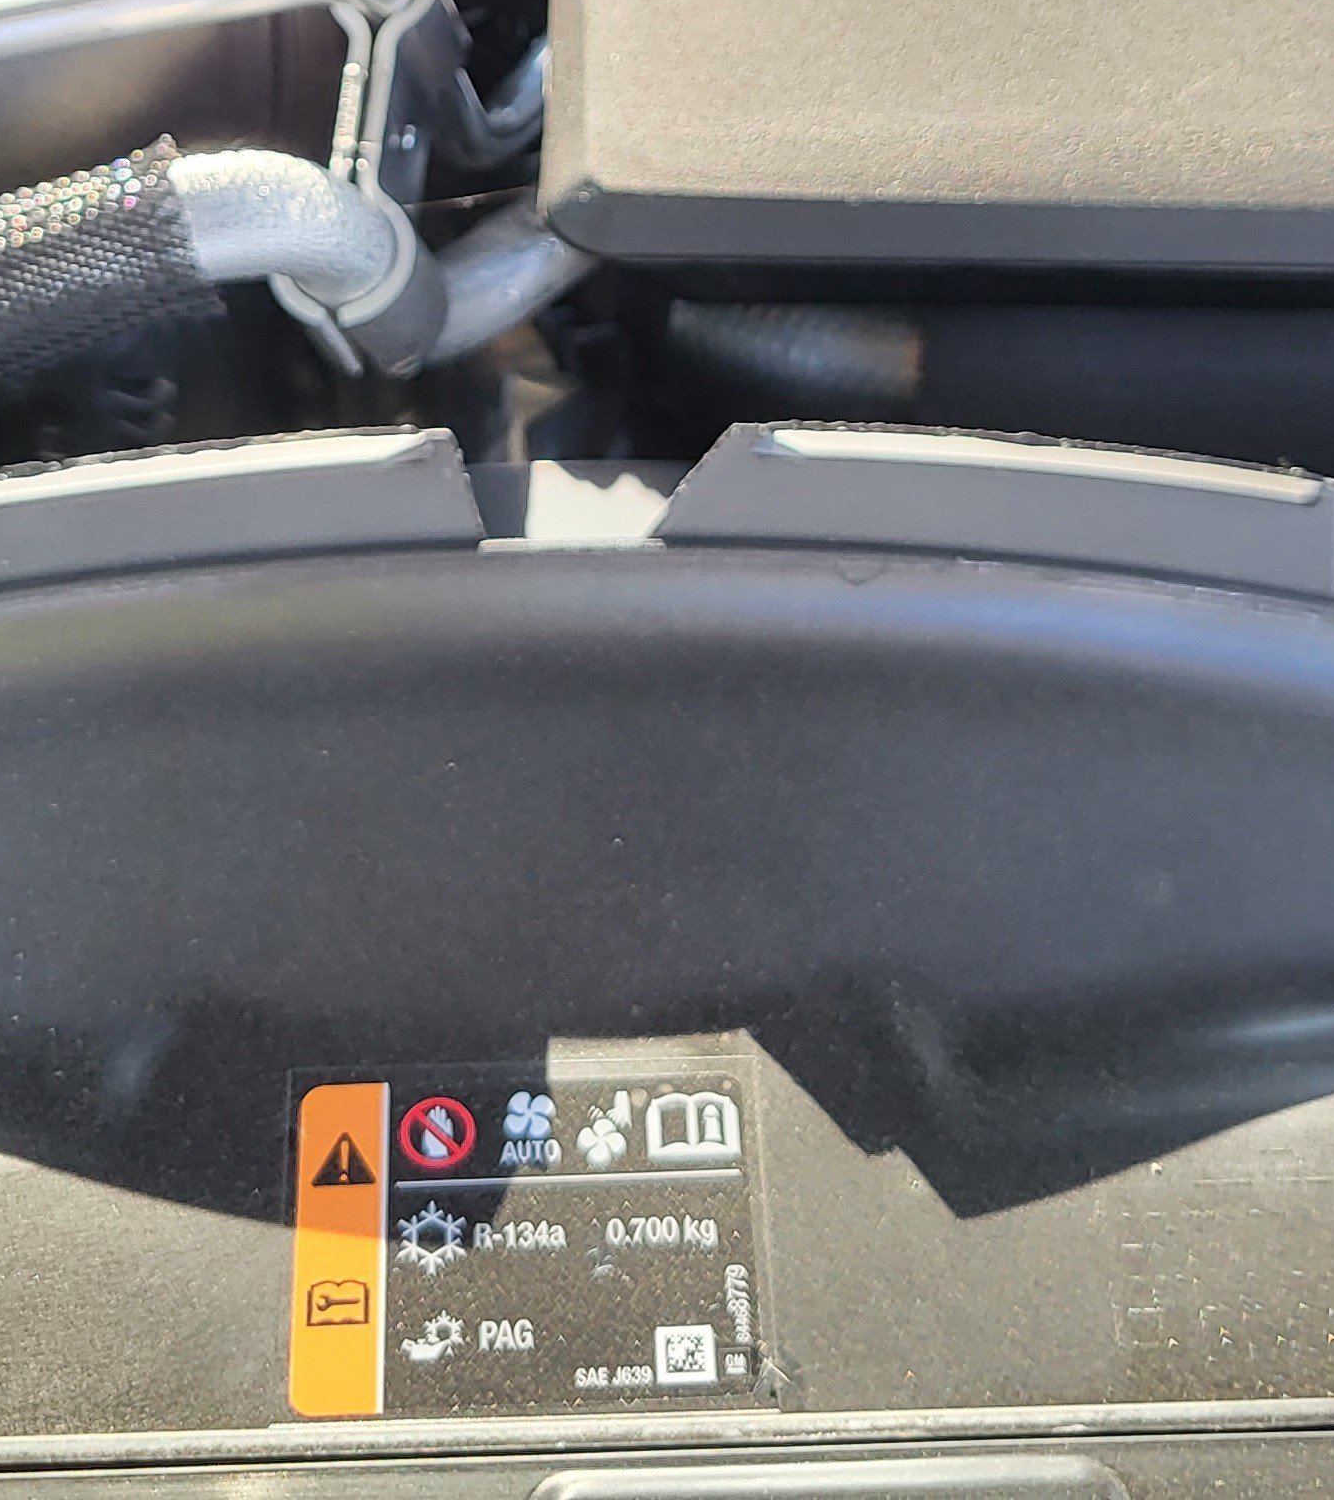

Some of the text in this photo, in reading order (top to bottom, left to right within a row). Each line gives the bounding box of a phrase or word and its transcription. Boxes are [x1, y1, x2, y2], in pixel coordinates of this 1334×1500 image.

[498, 1138, 563, 1166] AUTO
[472, 1213, 720, 1253] R-134a 0.700 kg
[478, 1317, 536, 1351] PAG
[574, 1364, 654, 1390] SAE J639
[724, 1352, 748, 1374] GM
